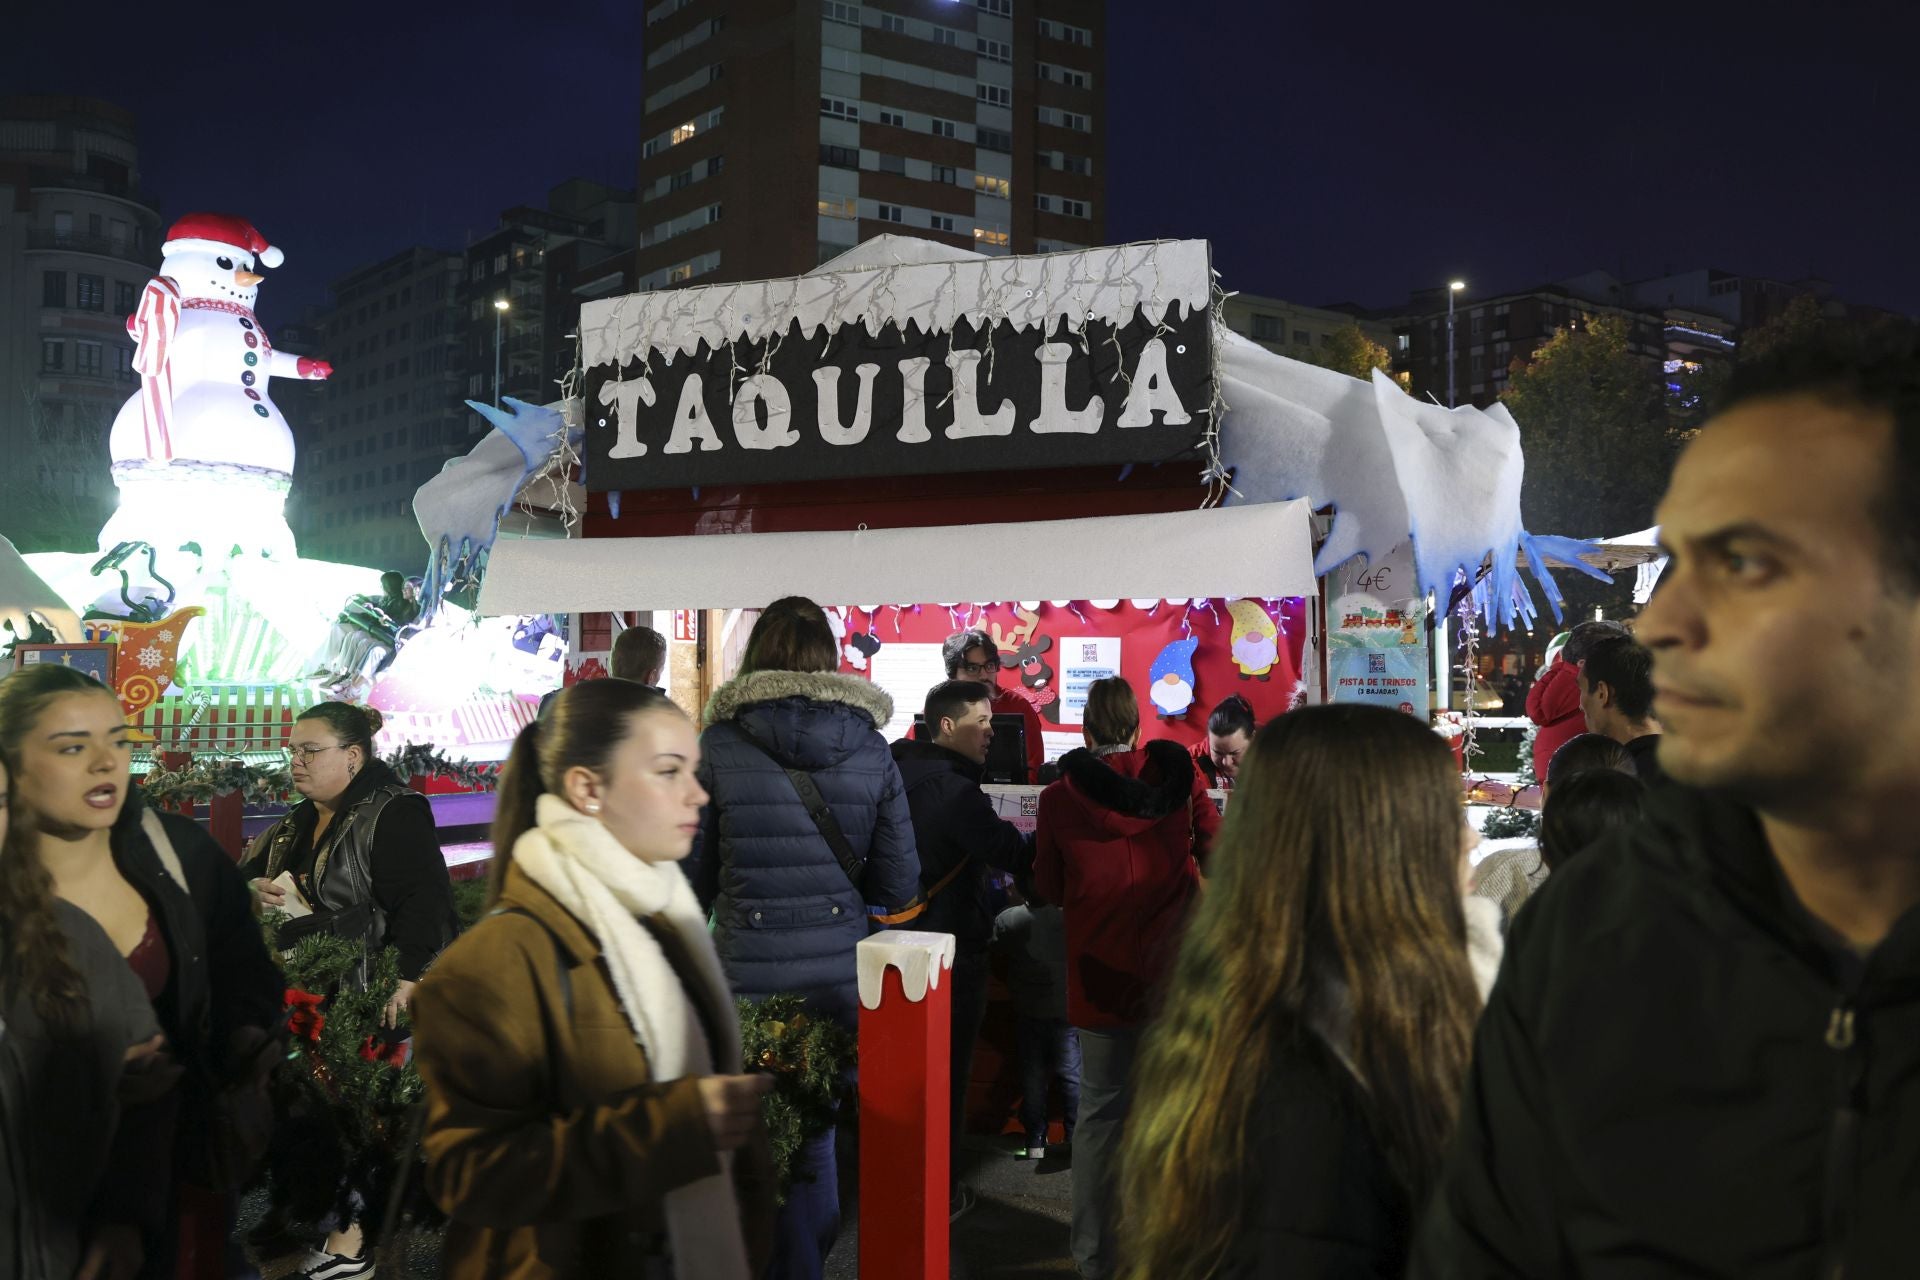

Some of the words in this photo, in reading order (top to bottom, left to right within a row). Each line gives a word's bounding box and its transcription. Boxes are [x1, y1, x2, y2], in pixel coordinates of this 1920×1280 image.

[598, 338, 1192, 460] TAQUILLA
[1356, 567, 1392, 593] 4€
[1339, 678, 1365, 687] PISTA
[1367, 678, 1378, 687] DE
[1380, 678, 1417, 687] TRINEOS
[1366, 688, 1399, 696] BAJADAS)
